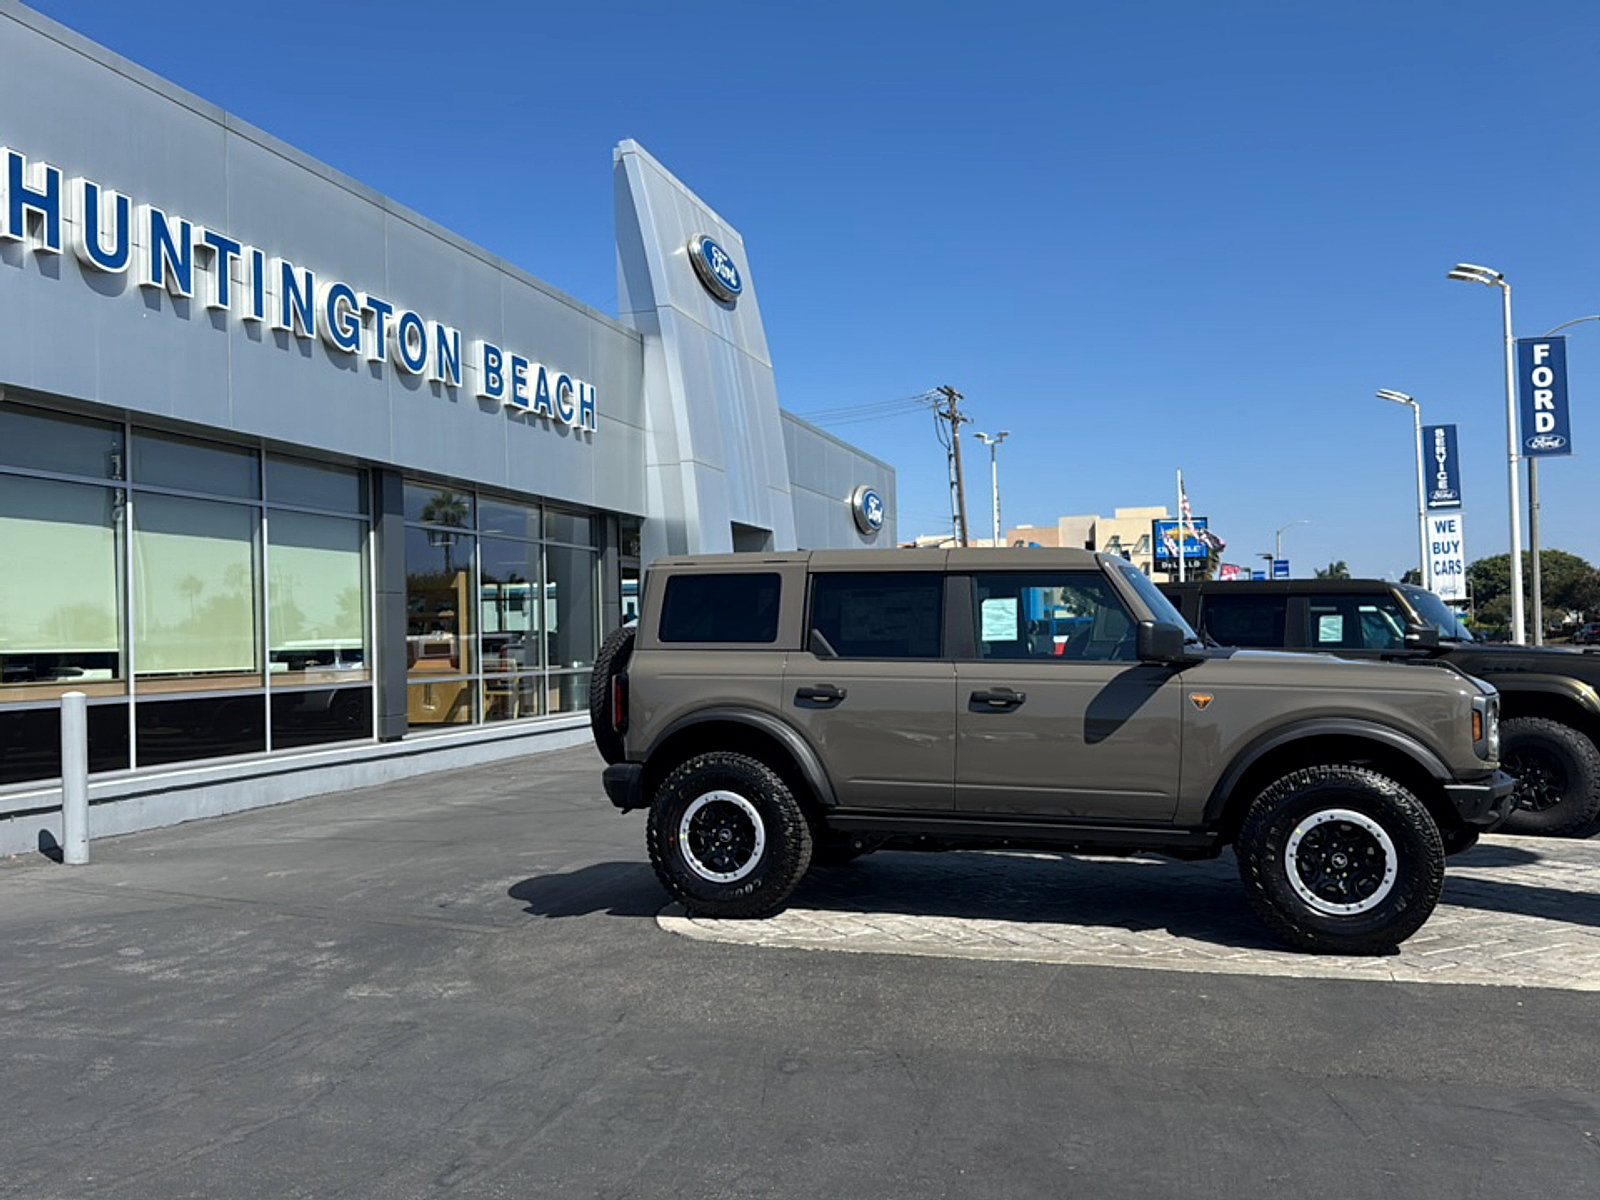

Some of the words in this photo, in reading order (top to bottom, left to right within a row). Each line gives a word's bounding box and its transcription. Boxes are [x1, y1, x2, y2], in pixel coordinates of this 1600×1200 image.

[711, 246, 737, 286] Ford
[4, 147, 463, 387] HUNTINGTON
[480, 341, 597, 432] BEACH
[1532, 344, 1555, 433] FORD
[1531, 436, 1560, 449] Ford
[1435, 520, 1456, 533] WE
[1433, 541, 1460, 554] BUY
[1434, 560, 1462, 575] CARS
